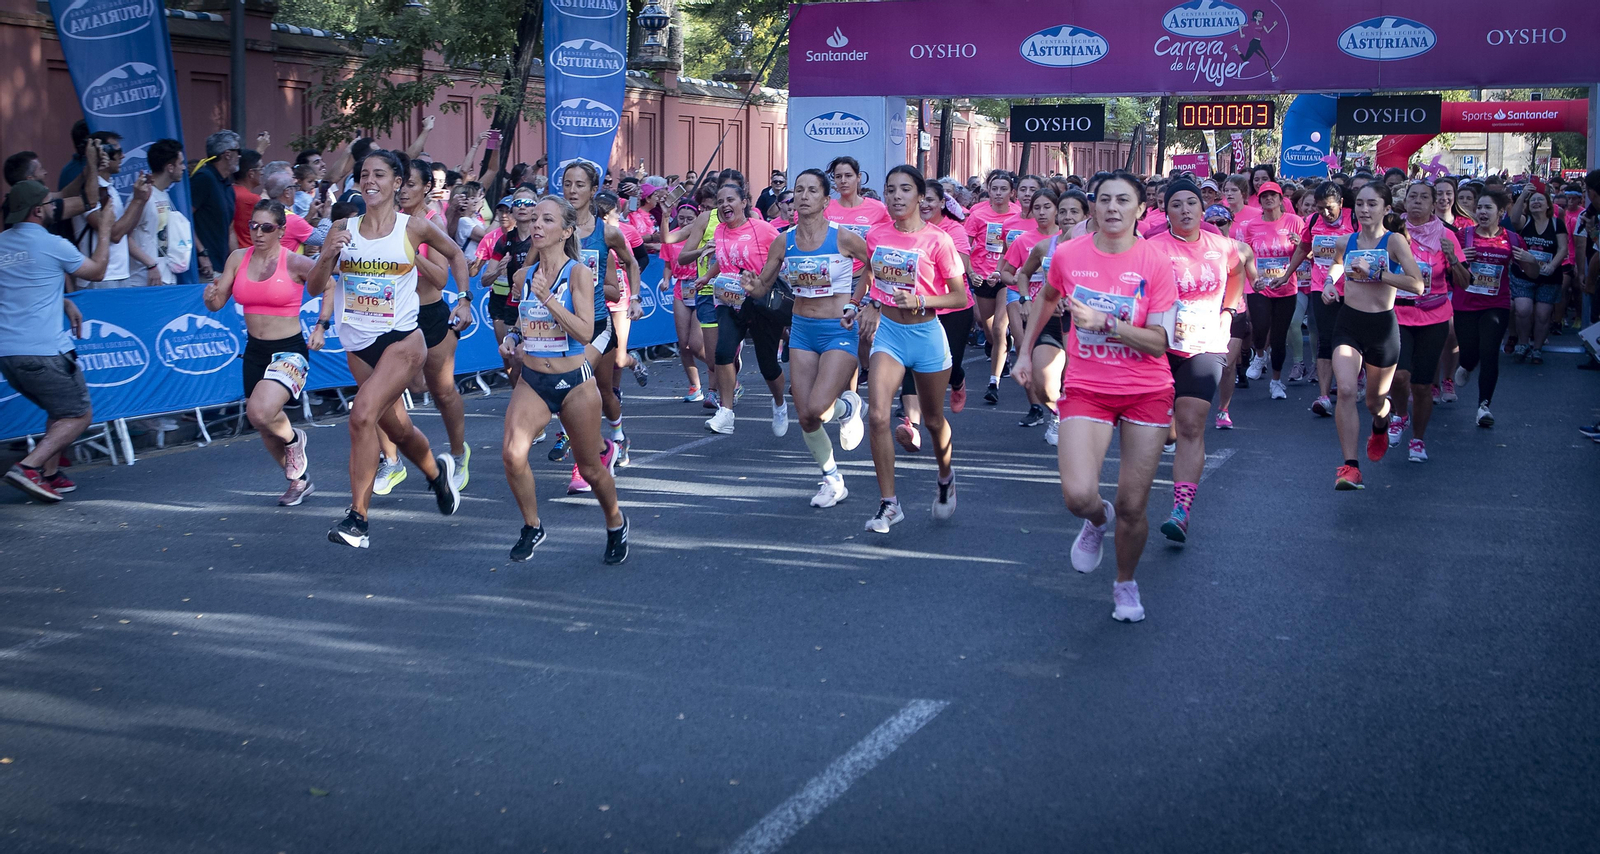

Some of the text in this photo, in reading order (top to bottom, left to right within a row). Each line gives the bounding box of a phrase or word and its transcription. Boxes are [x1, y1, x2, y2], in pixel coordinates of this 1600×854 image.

[1168, 13, 1240, 29] ASTURIANA
[1345, 33, 1428, 50] ASTURIANA
[1486, 28, 1567, 46] OYSHO
[910, 43, 977, 59] OYSHO
[1027, 40, 1102, 57] ASTURIANA
[1154, 36, 1223, 56] Carrera
[556, 52, 620, 69] ASTURIANA
[806, 49, 868, 62] Santander
[1170, 53, 1249, 87] de la Mujer
[1183, 105, 1268, 126] 00:00:03
[1353, 108, 1427, 123] OYSHO
[1462, 110, 1558, 122] Sports Santander
[809, 124, 865, 136] ASTURIANA
[1025, 117, 1091, 132] OYSHO
[1286, 152, 1321, 161] ASTURIANA
[344, 257, 398, 270] eMotion
[882, 266, 902, 276] 016
[357, 296, 379, 306] 016
[724, 292, 740, 300] 016
[530, 321, 548, 330] 016
[164, 338, 234, 362] ASTURIANA
[1078, 344, 1142, 359] SUMA
[78, 350, 146, 372] STURIANA
